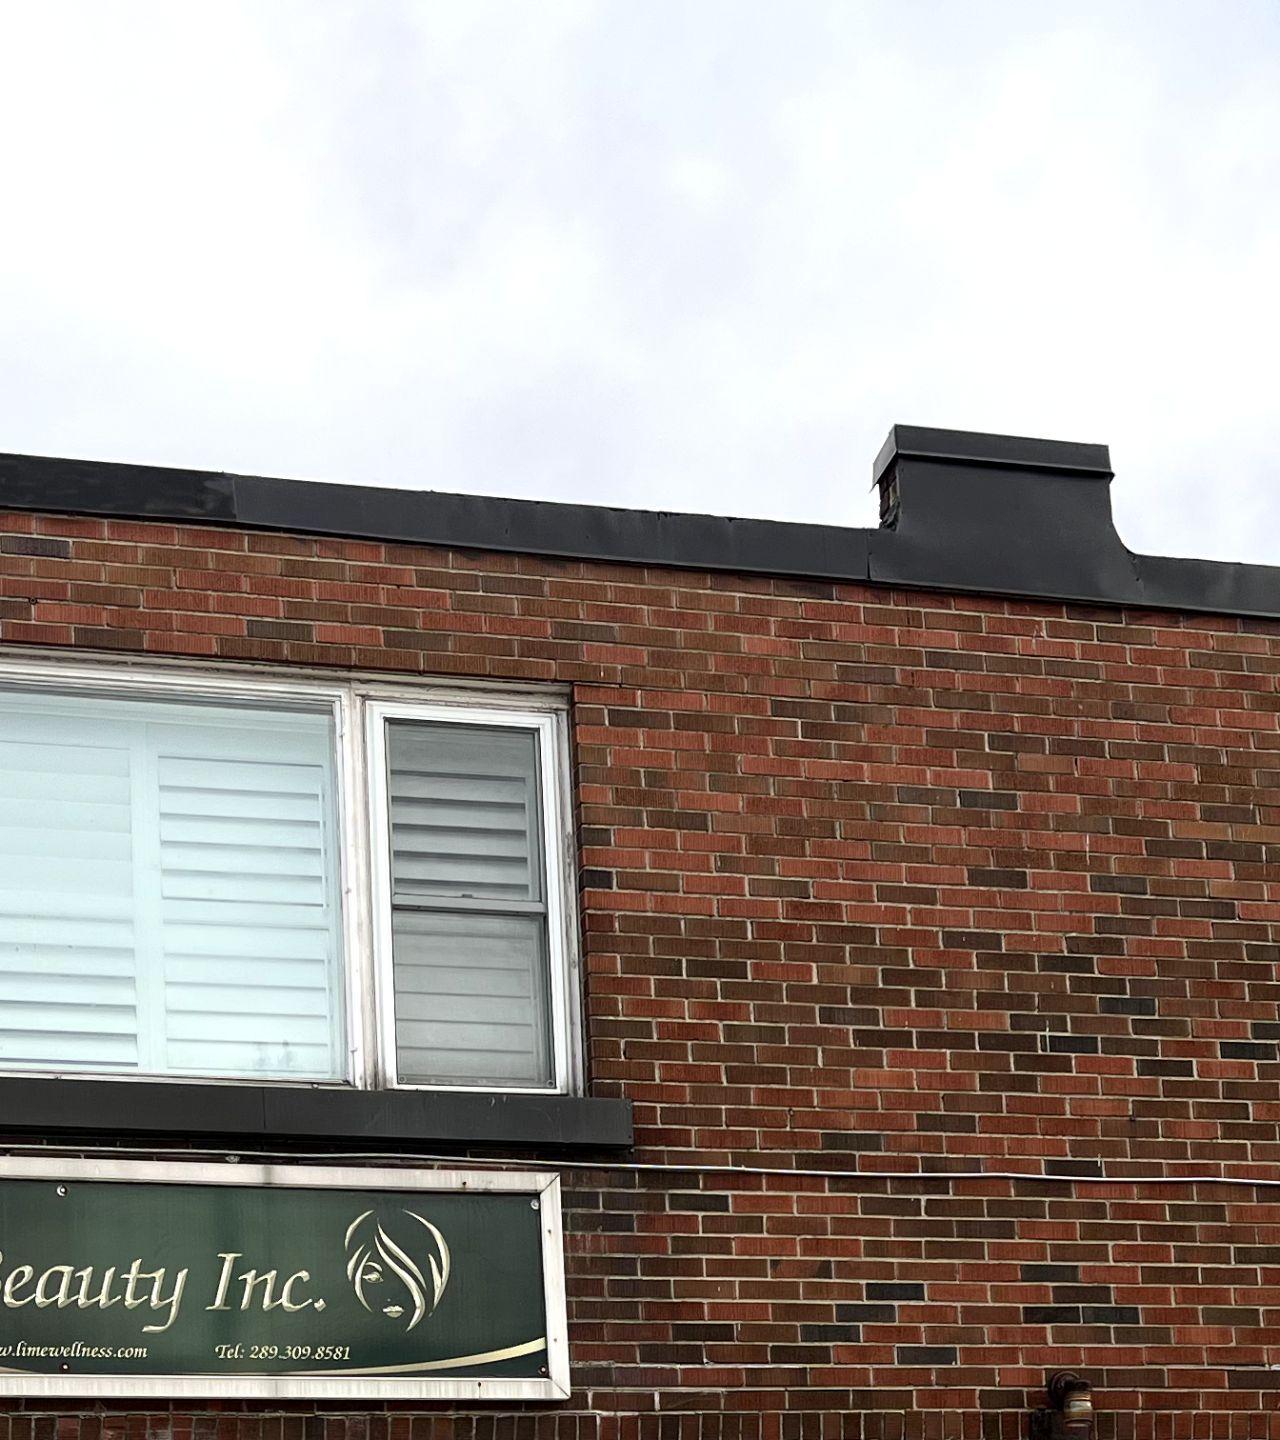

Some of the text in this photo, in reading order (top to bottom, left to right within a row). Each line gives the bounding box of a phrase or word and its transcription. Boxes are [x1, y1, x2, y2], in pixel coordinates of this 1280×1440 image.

[205, 1252, 328, 1313] Inc.
[215, 1344, 351, 1361] Tel: 289.309.8581
